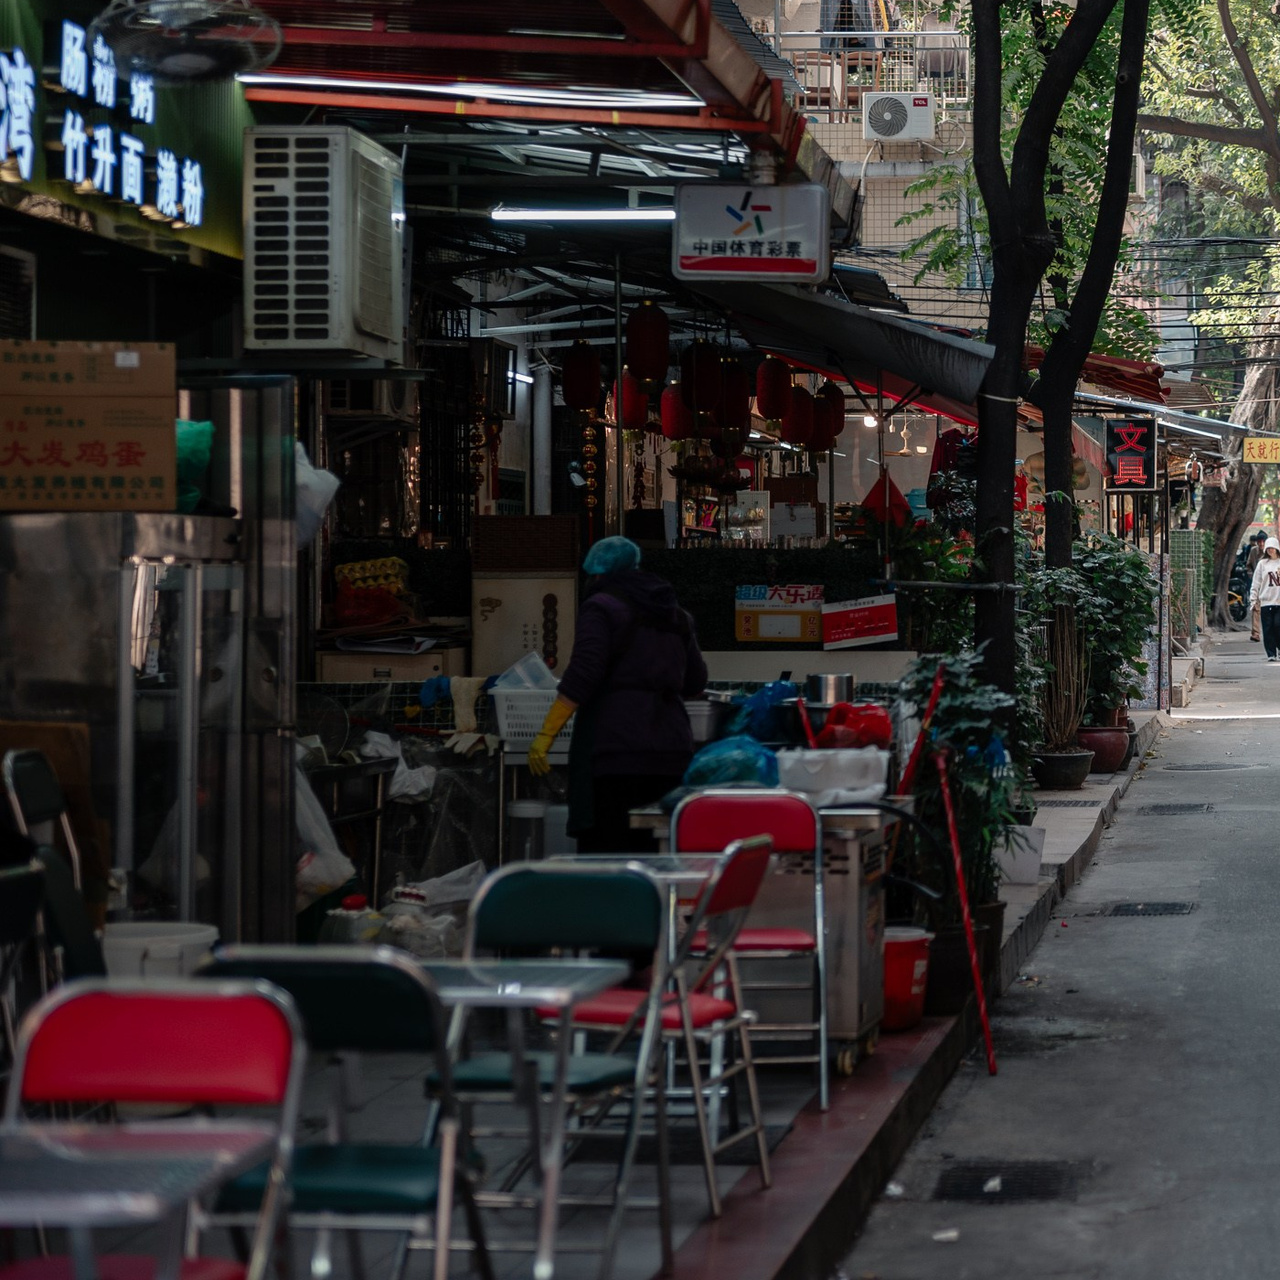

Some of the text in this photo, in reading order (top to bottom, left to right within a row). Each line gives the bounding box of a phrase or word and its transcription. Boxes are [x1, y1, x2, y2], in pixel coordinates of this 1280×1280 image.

[693, 239, 802, 257] 中国体育彩票
[0, 440, 147, 468] 大发鸡蛋
[1114, 422, 1147, 485] 文具
[1246, 441, 1280, 460] 天就行
[736, 584, 824, 604] 超级大乐透
